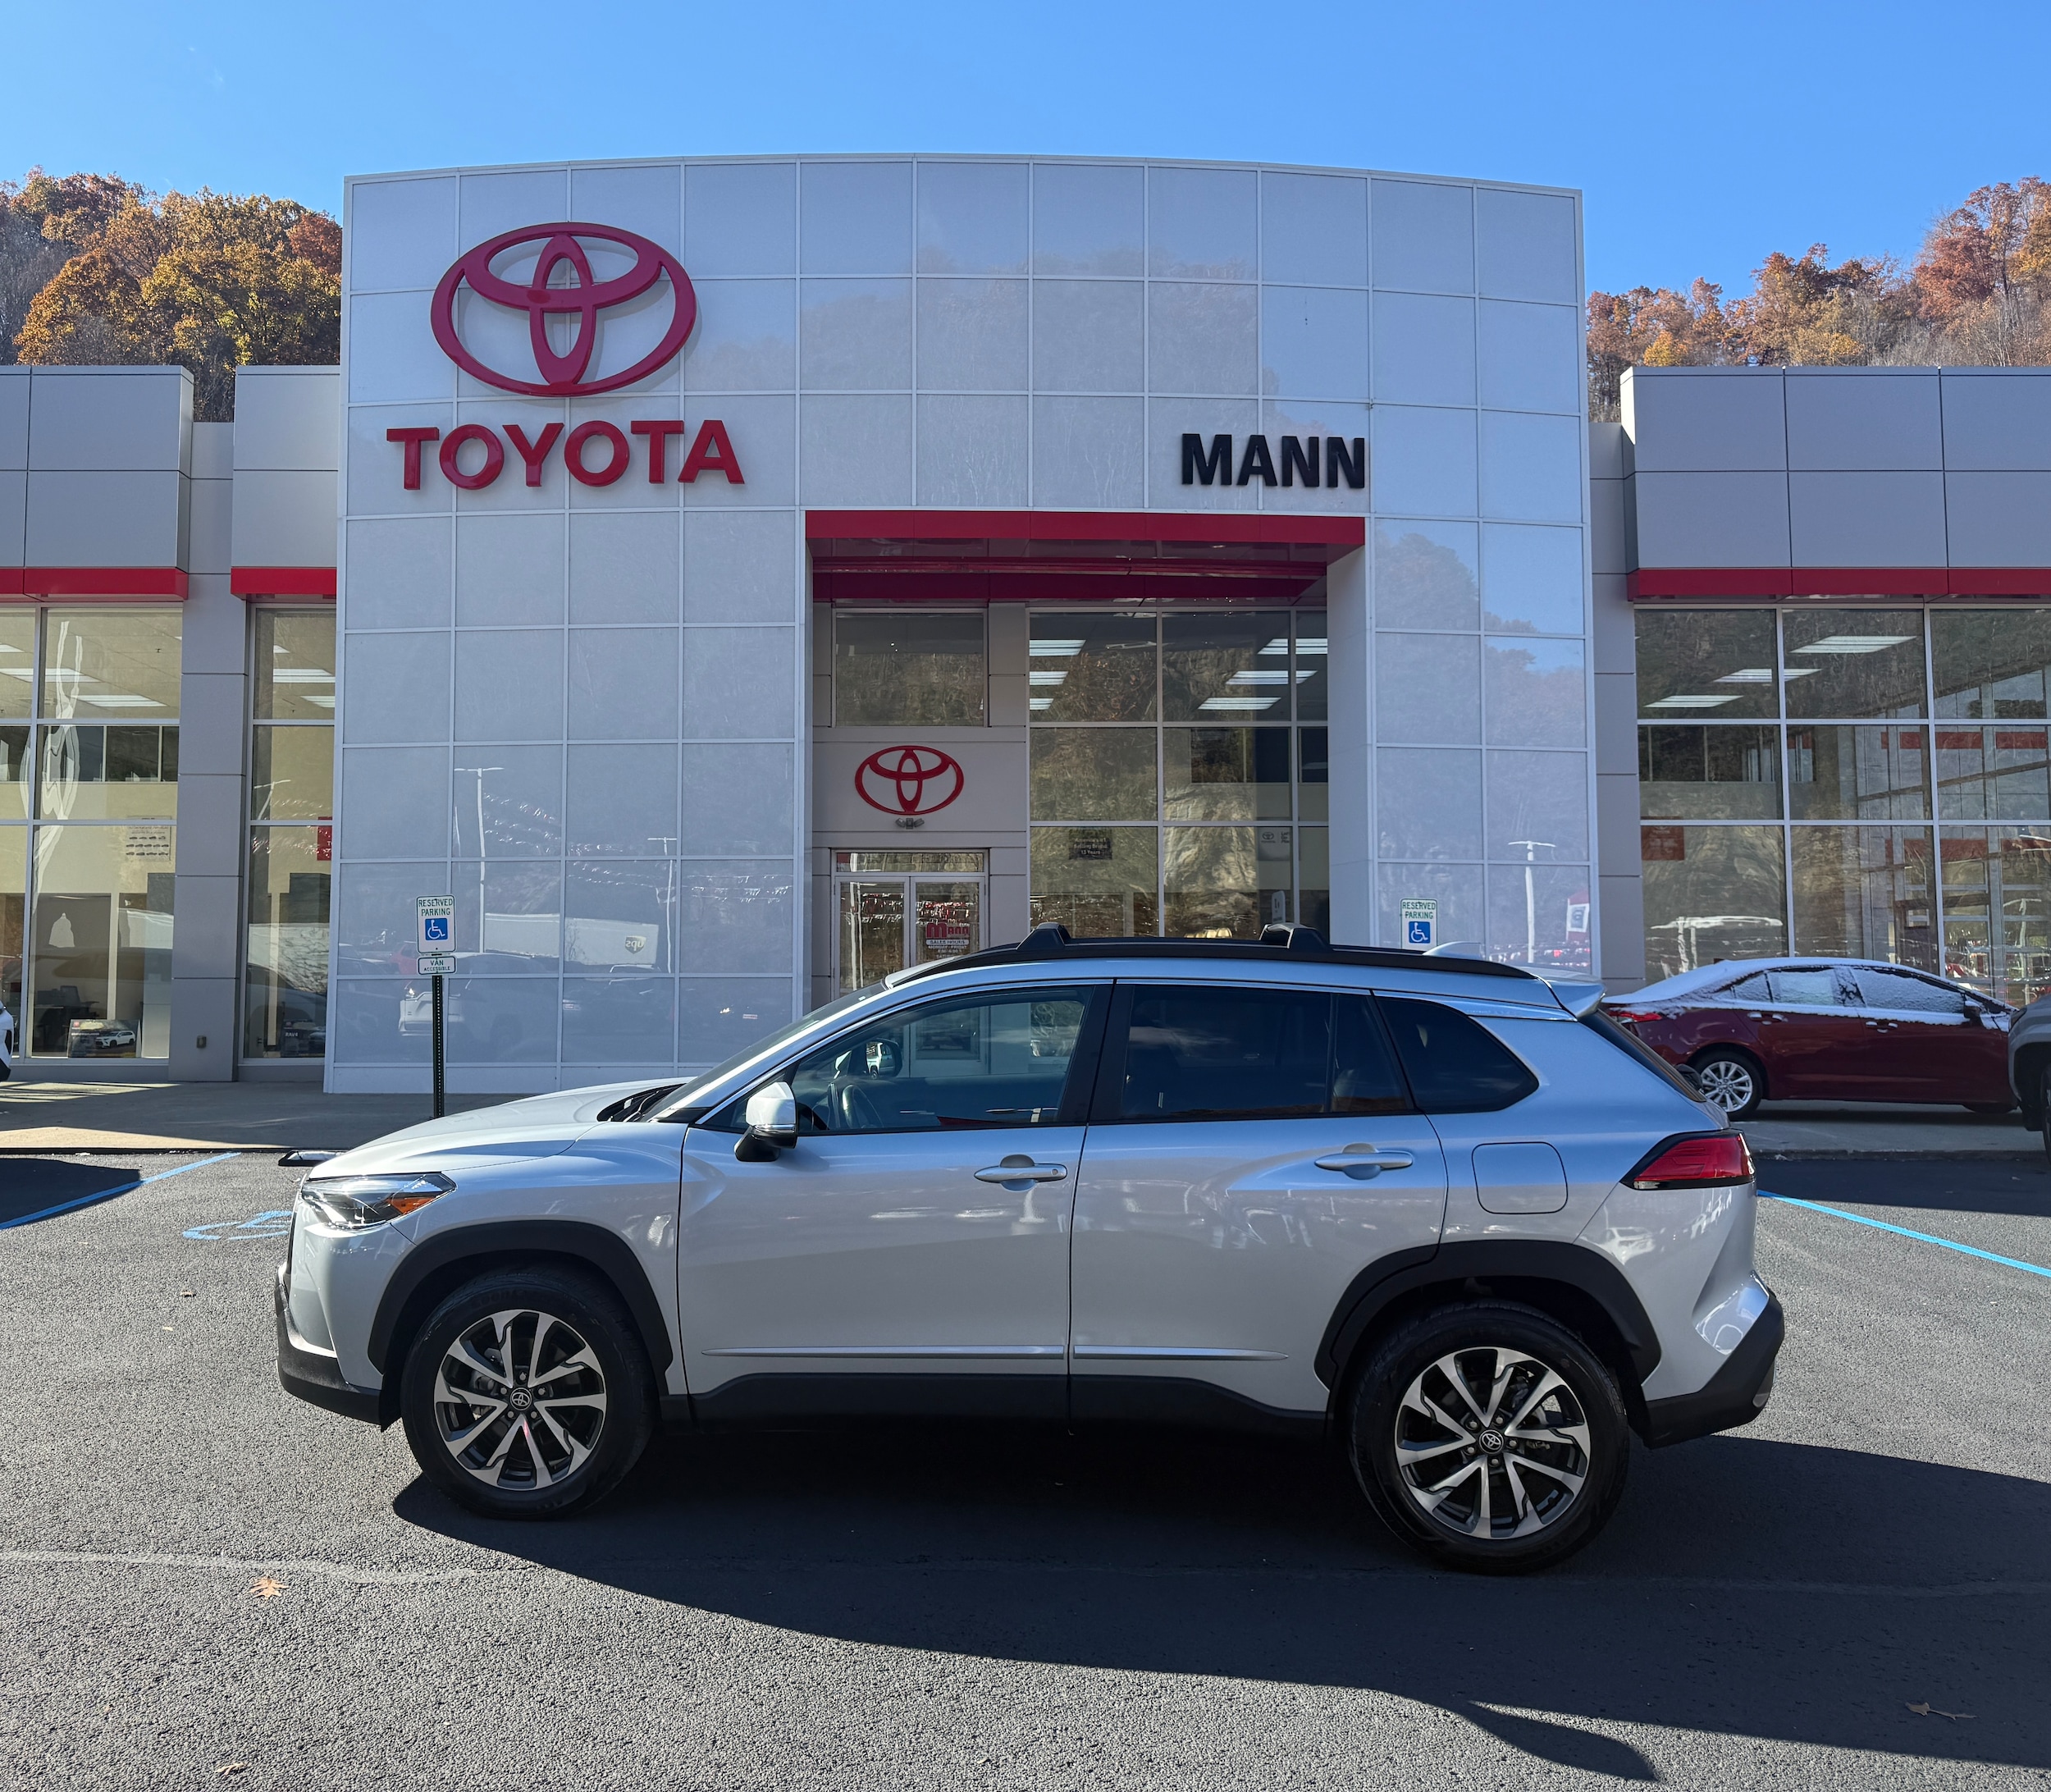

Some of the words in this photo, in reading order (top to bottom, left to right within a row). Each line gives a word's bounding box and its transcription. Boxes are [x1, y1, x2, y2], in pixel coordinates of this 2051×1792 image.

[386, 419, 745, 490] TOYOTA
[1181, 433, 1365, 488] MANN
[418, 898, 453, 907] RESERVED
[1403, 902, 1435, 910] RESERVED
[1405, 911, 1433, 919] PARKING
